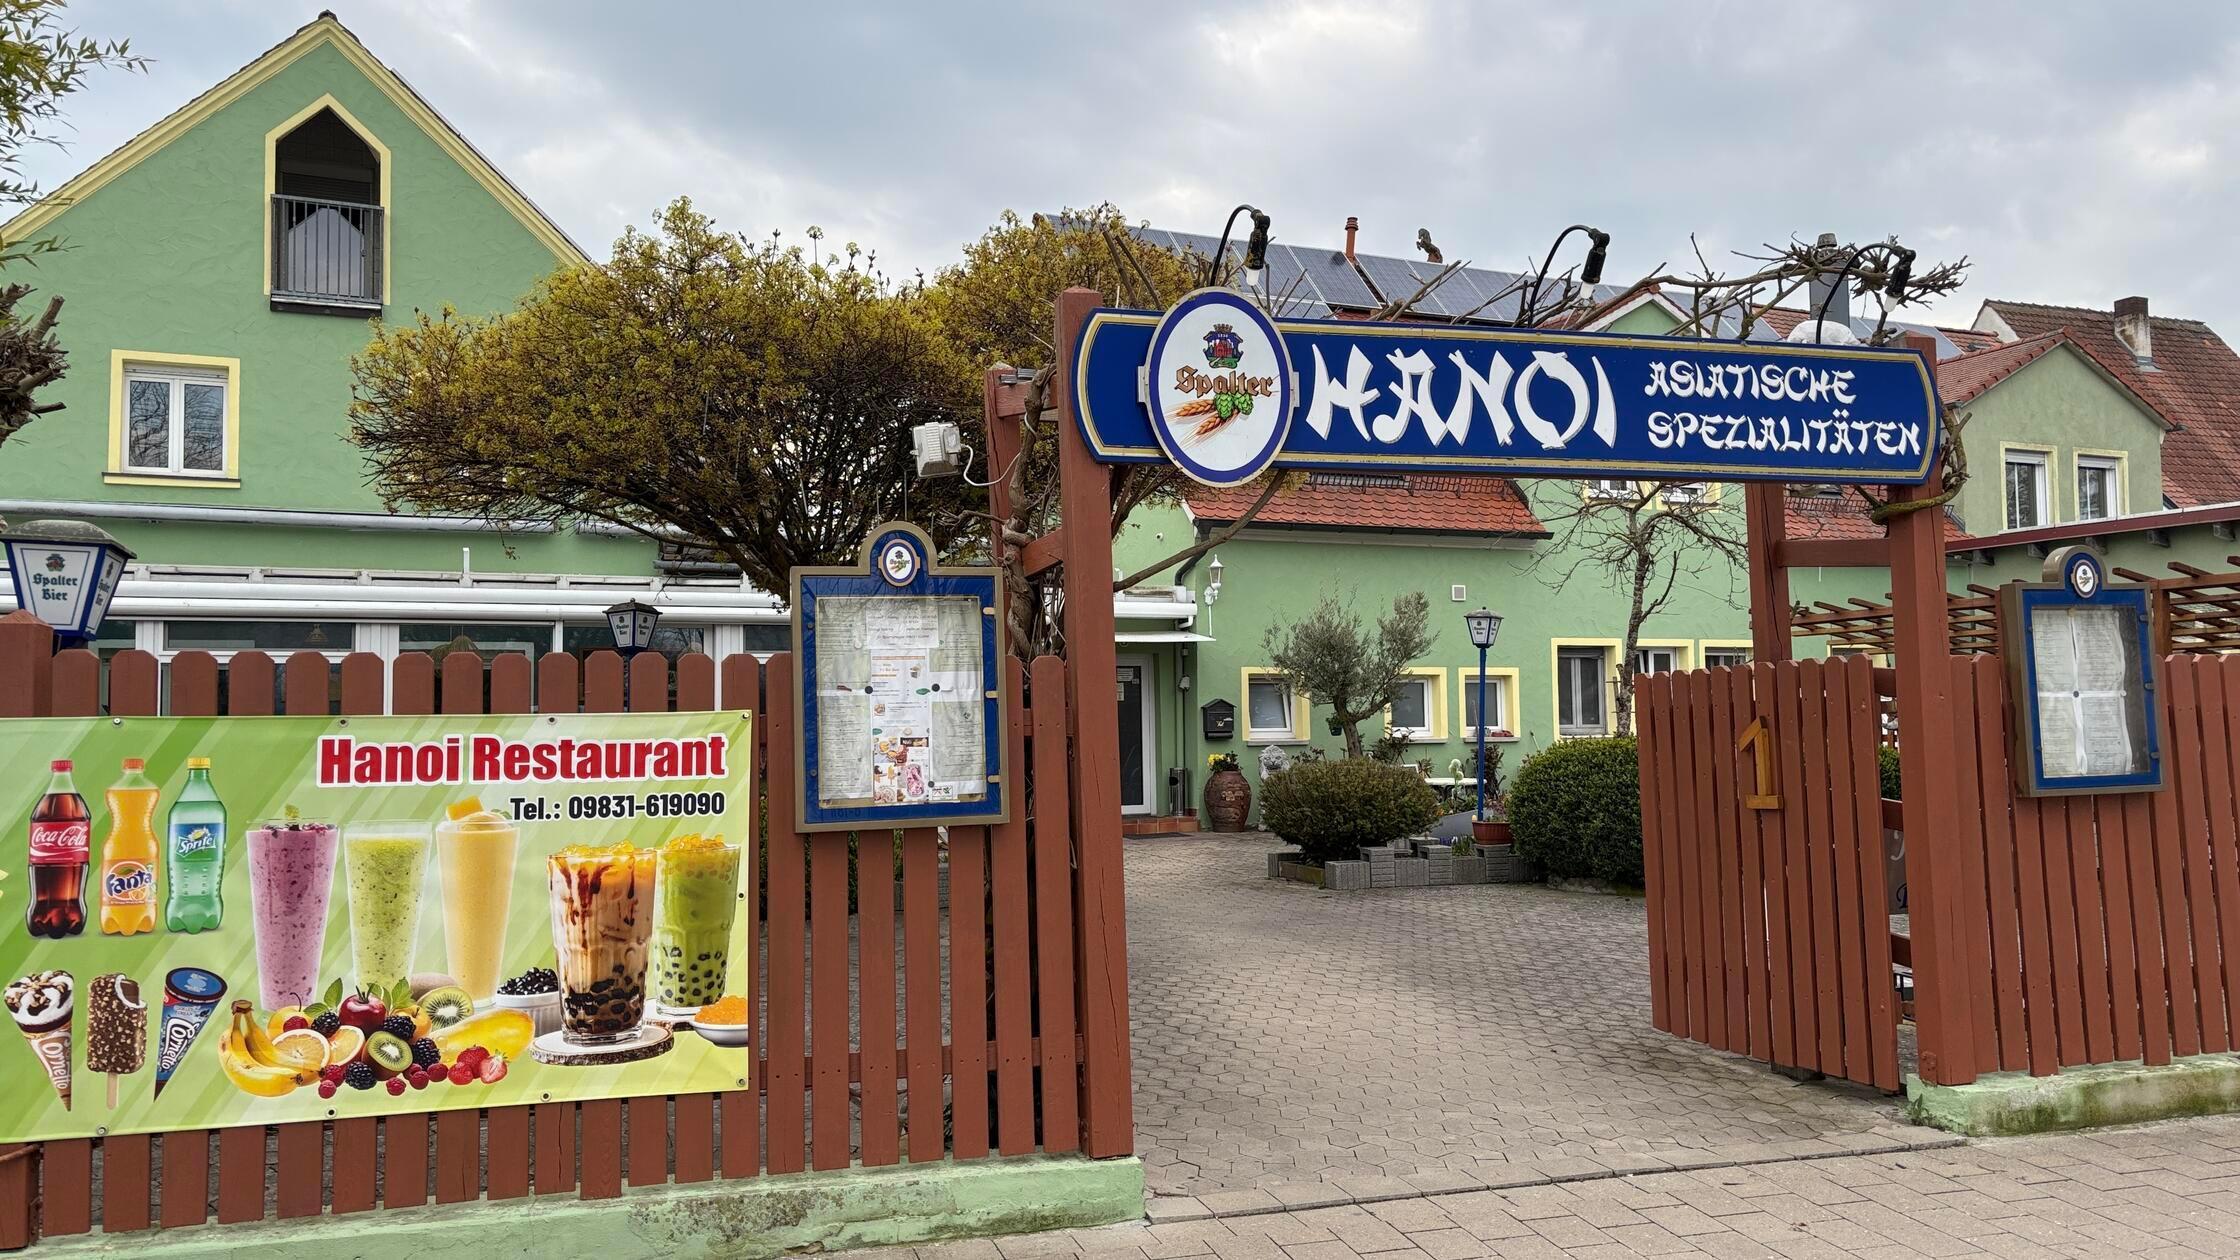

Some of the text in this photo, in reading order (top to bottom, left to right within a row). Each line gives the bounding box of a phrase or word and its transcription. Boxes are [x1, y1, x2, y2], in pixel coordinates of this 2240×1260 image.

[1174, 365, 1273, 398] Spalter
[1305, 343, 1617, 451] HANOI
[1644, 360, 1857, 405] ASIATISCHE
[1647, 408, 1921, 456] SPEZIALITÄTEN
[32, 573, 78, 587] Spalter
[41, 588, 68, 601] Bier
[319, 736, 726, 784] Hanoi Restaurant
[510, 792, 725, 820] Tel.: 09831-619090
[179, 836, 213, 853] Sprite
[163, 1018, 200, 1070] Cornetto
